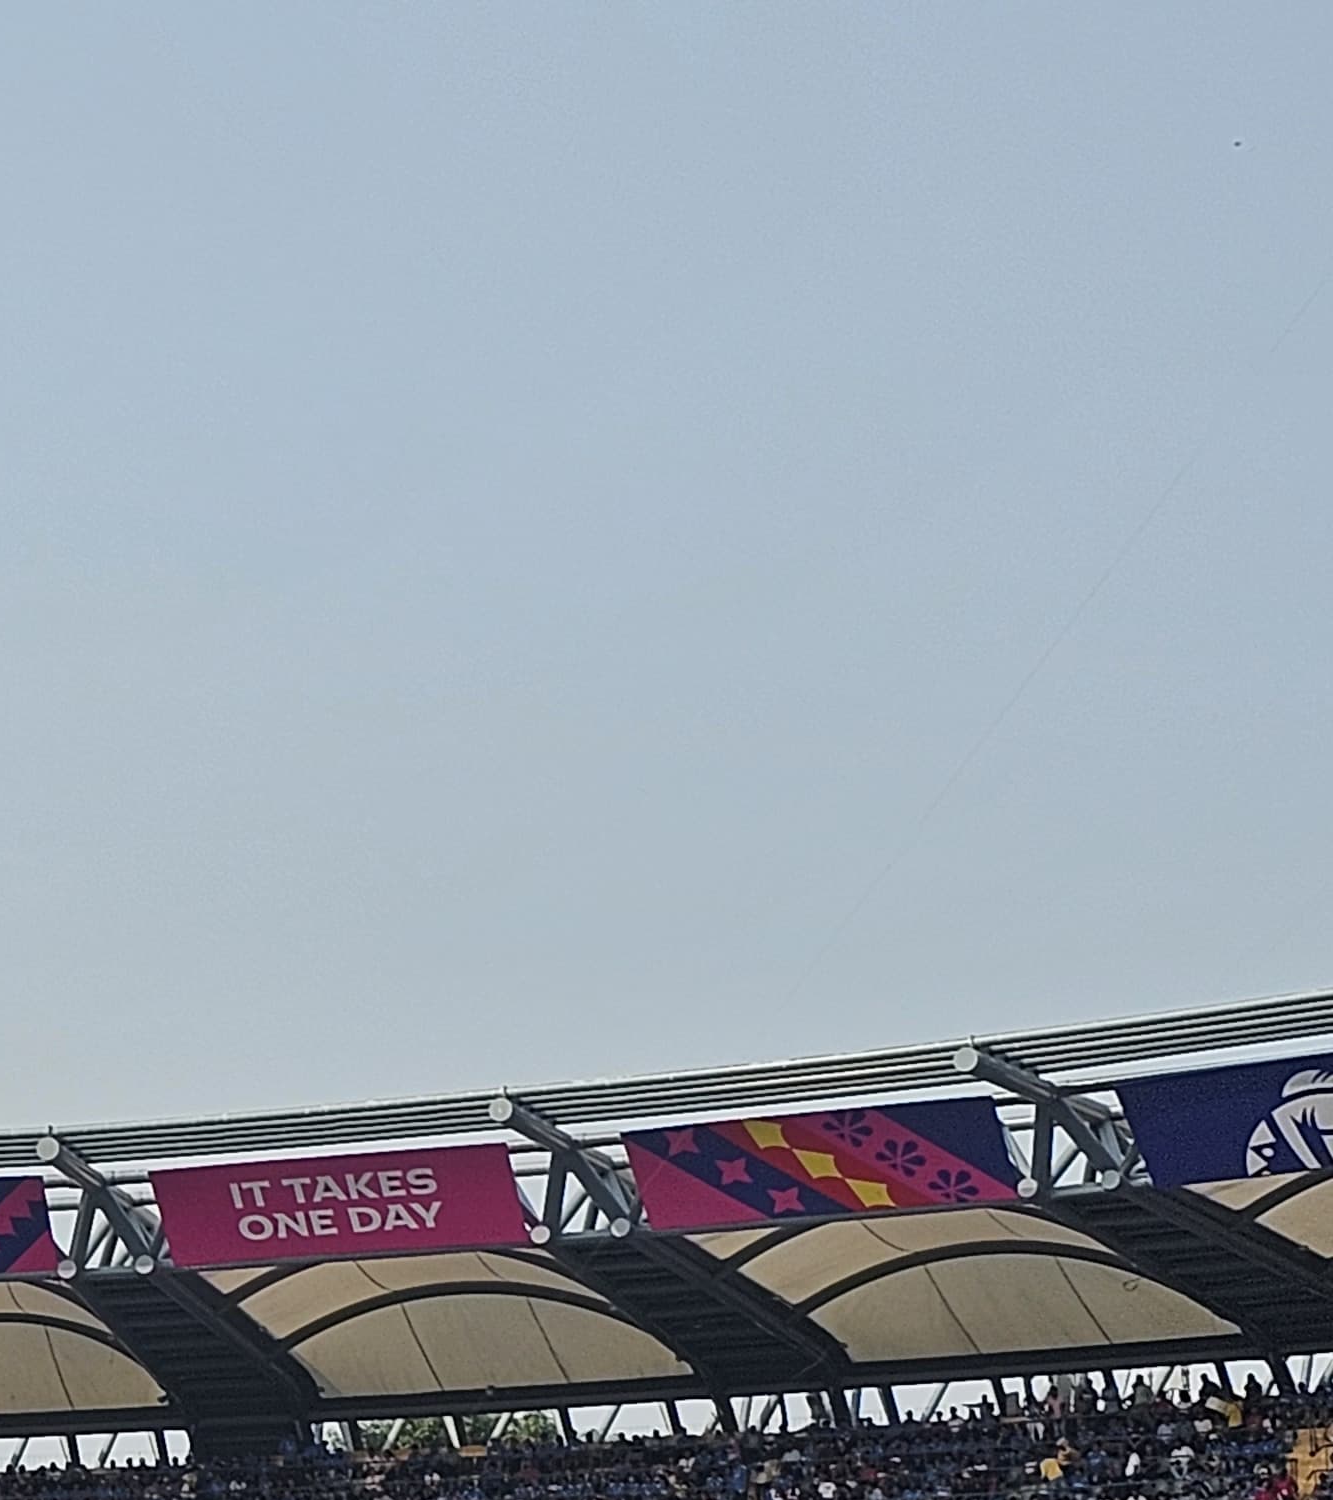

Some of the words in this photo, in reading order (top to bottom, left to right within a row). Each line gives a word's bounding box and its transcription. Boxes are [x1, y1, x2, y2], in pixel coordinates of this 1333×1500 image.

[230, 1180, 270, 1208] IT
[282, 1168, 437, 1204] TAKES
[239, 1209, 338, 1240] ONE
[349, 1201, 442, 1234] DAY
